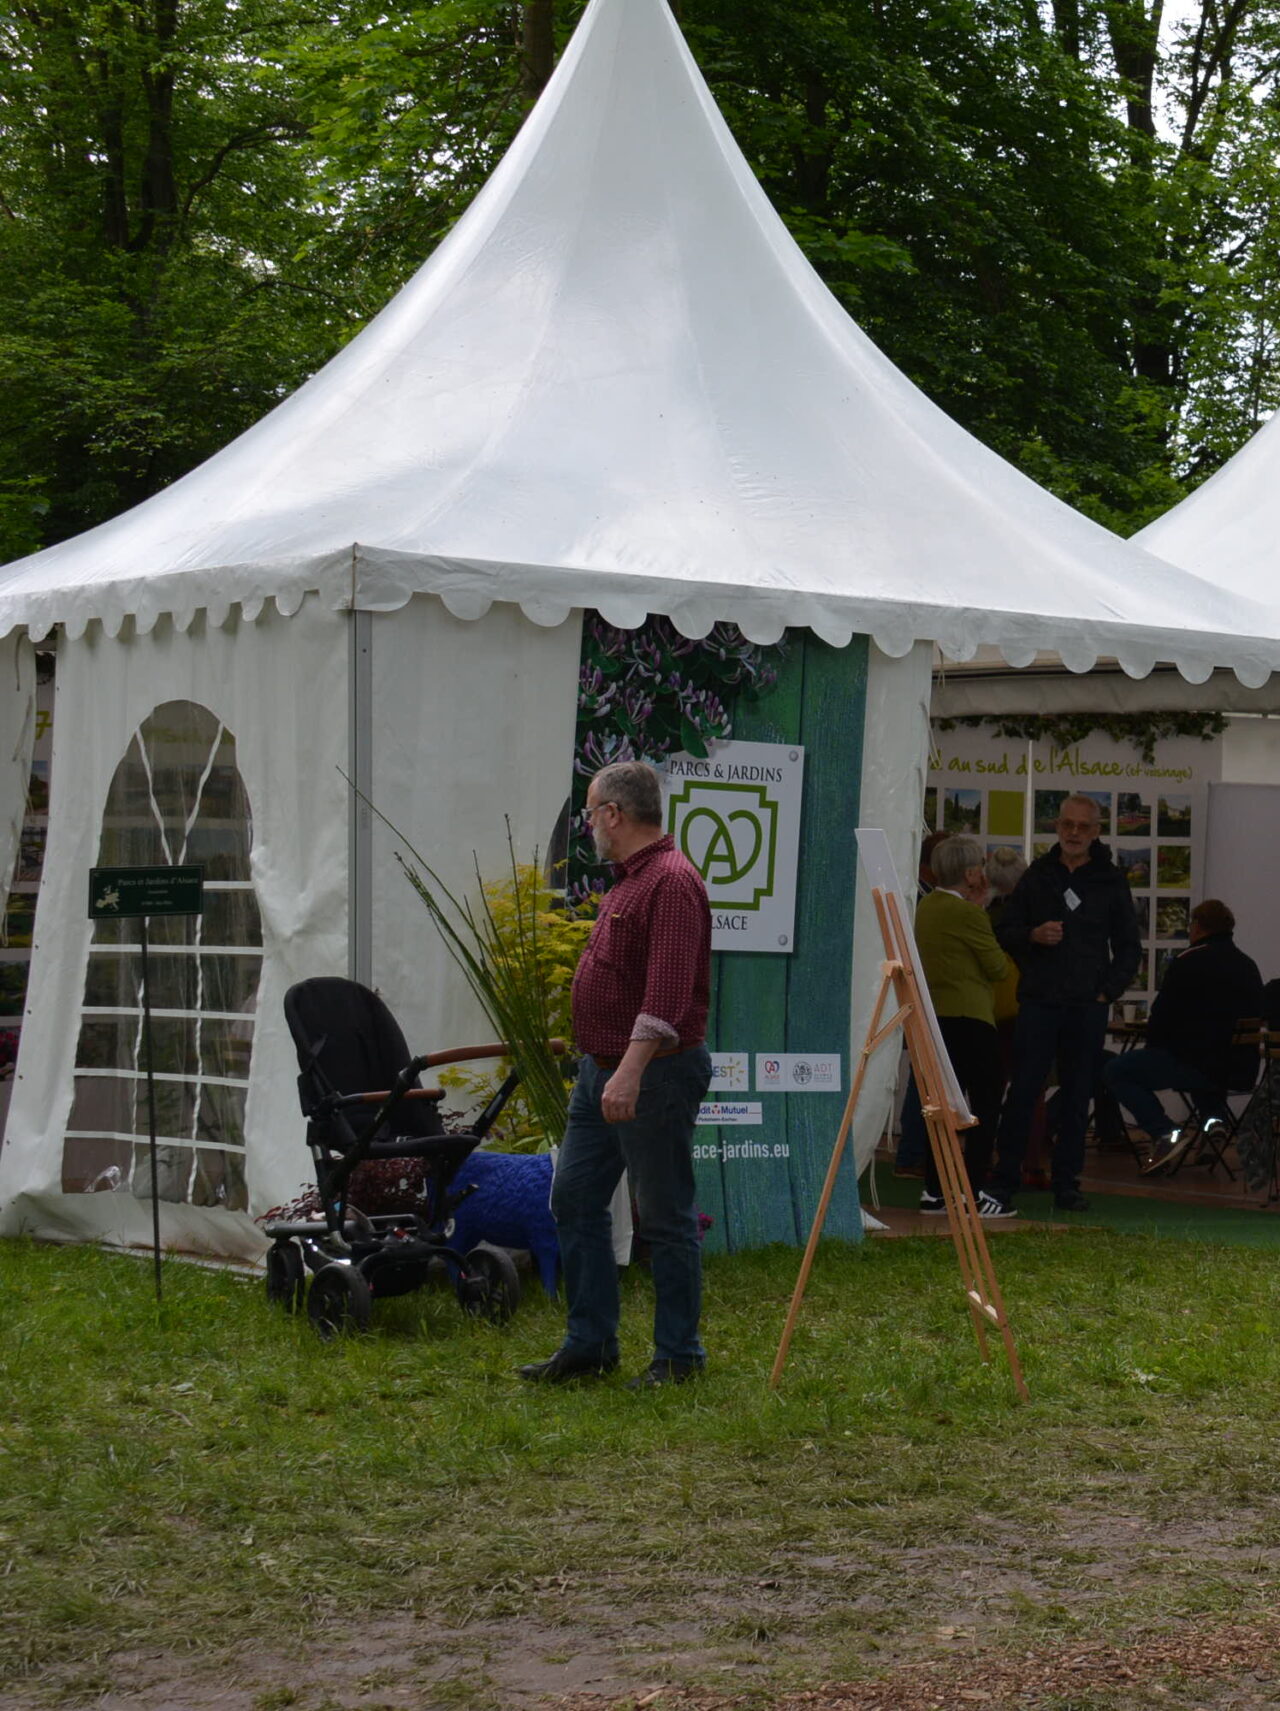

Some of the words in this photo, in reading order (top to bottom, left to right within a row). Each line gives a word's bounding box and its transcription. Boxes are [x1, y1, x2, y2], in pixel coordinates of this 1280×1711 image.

[670, 760, 710, 777] PARCS
[713, 763, 724, 778] &
[726, 764, 783, 783] JARDINS
[948, 756, 971, 772] au
[975, 752, 1009, 774] sud
[1050, 746, 1124, 776] l'Alsace
[700, 1104, 711, 1115] dit
[721, 1105, 748, 1115] Mutuel
[693, 1140, 790, 1163] ace-jardins.eu
